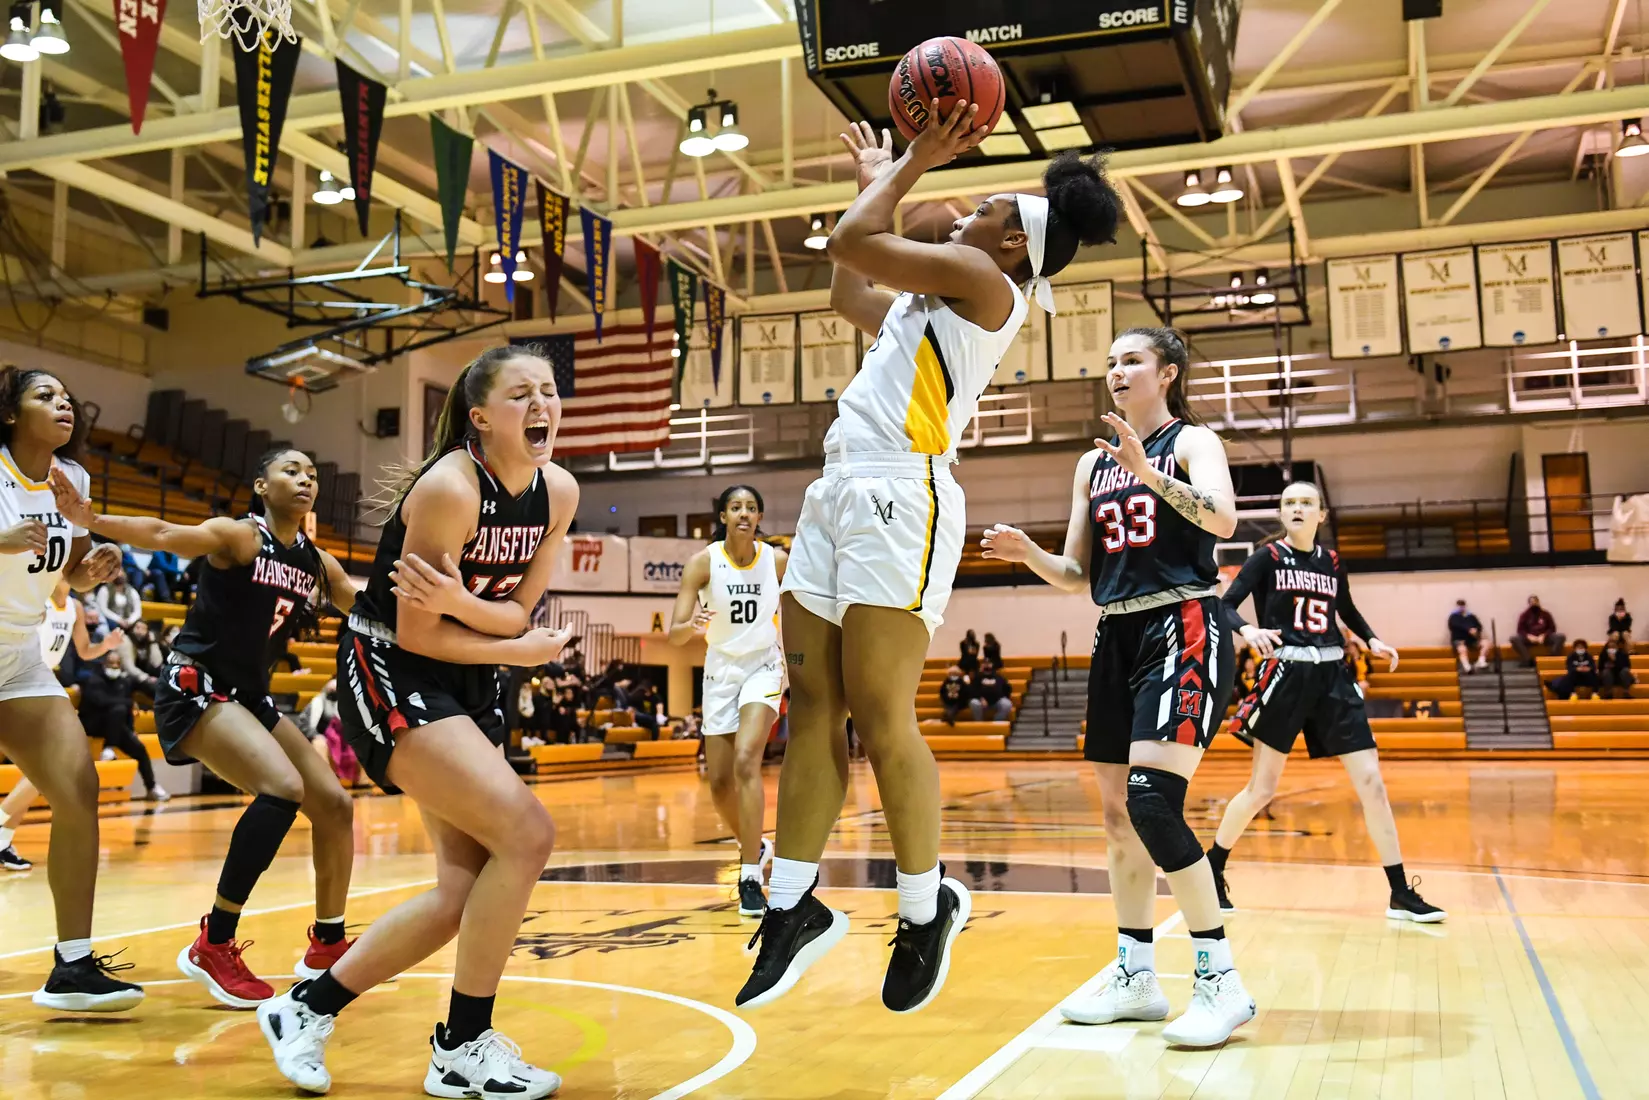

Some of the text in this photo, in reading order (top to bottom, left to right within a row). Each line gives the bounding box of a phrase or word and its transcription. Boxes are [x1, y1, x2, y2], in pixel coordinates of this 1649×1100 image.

[1099, 7, 1159, 29] SCORE
[965, 24, 1023, 44] MATCH
[825, 42, 879, 62] SCORE
[1095, 493, 1157, 554] 33
[726, 583, 762, 596] VILLE
[1275, 569, 1338, 599] MANSFIELD
[653, 612, 664, 632] A
[730, 600, 758, 624] 20
[1293, 596, 1329, 634] 15
[1177, 689, 1202, 718] M
